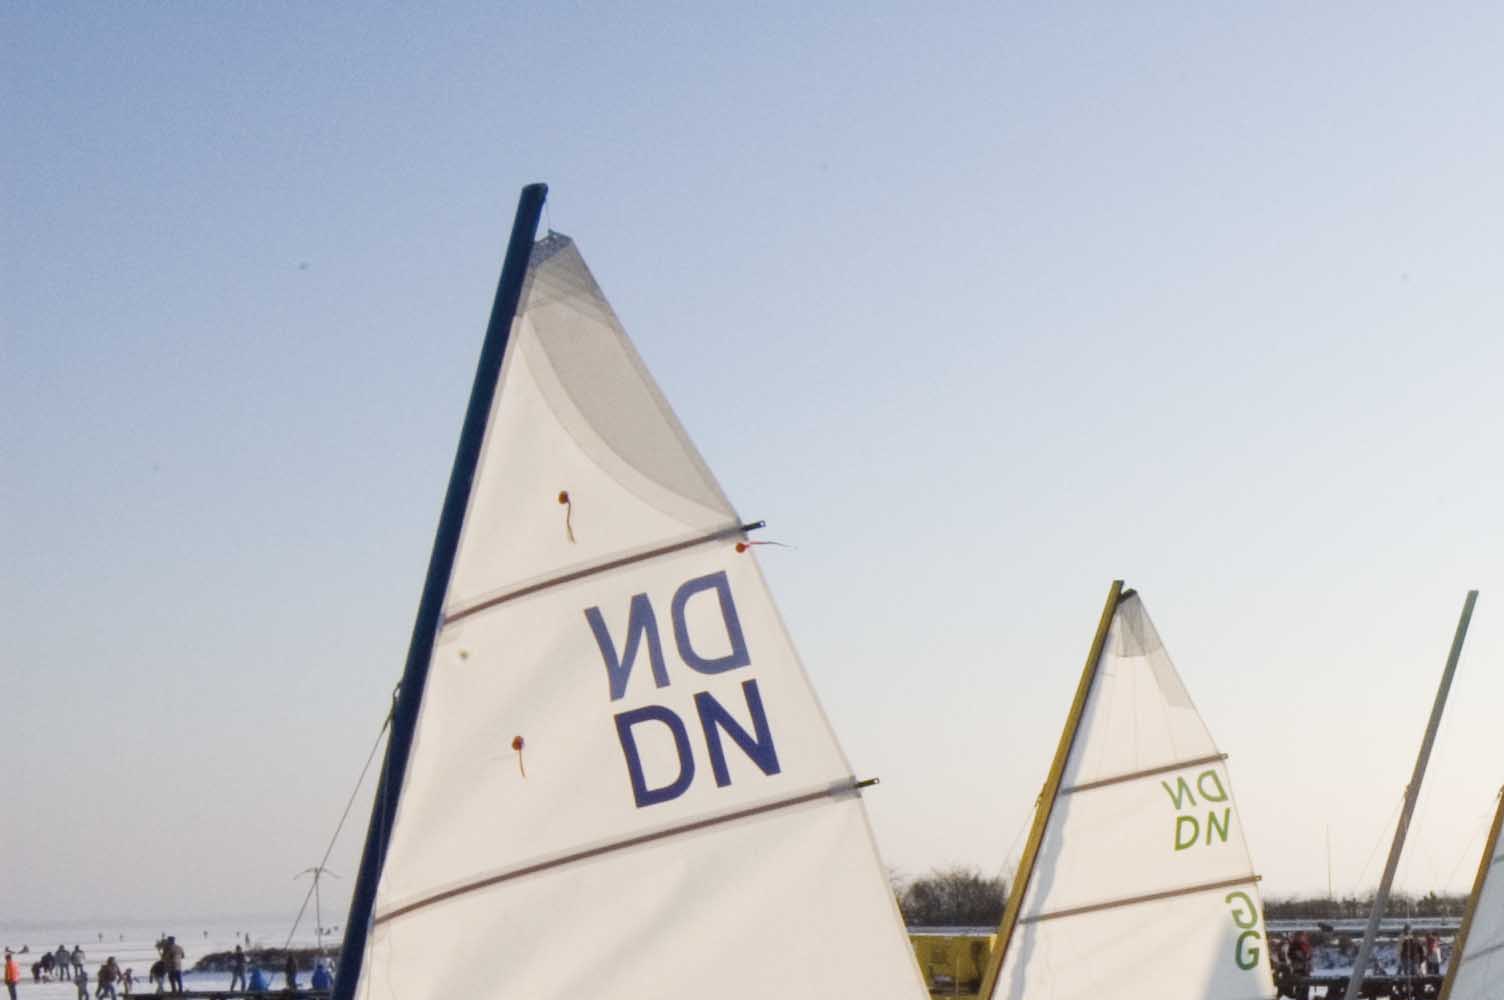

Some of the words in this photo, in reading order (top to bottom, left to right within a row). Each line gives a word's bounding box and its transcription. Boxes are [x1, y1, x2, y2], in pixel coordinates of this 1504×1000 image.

[613, 678, 782, 809] DN
[1173, 807, 1231, 851] DN
[1235, 930, 1261, 970] G
